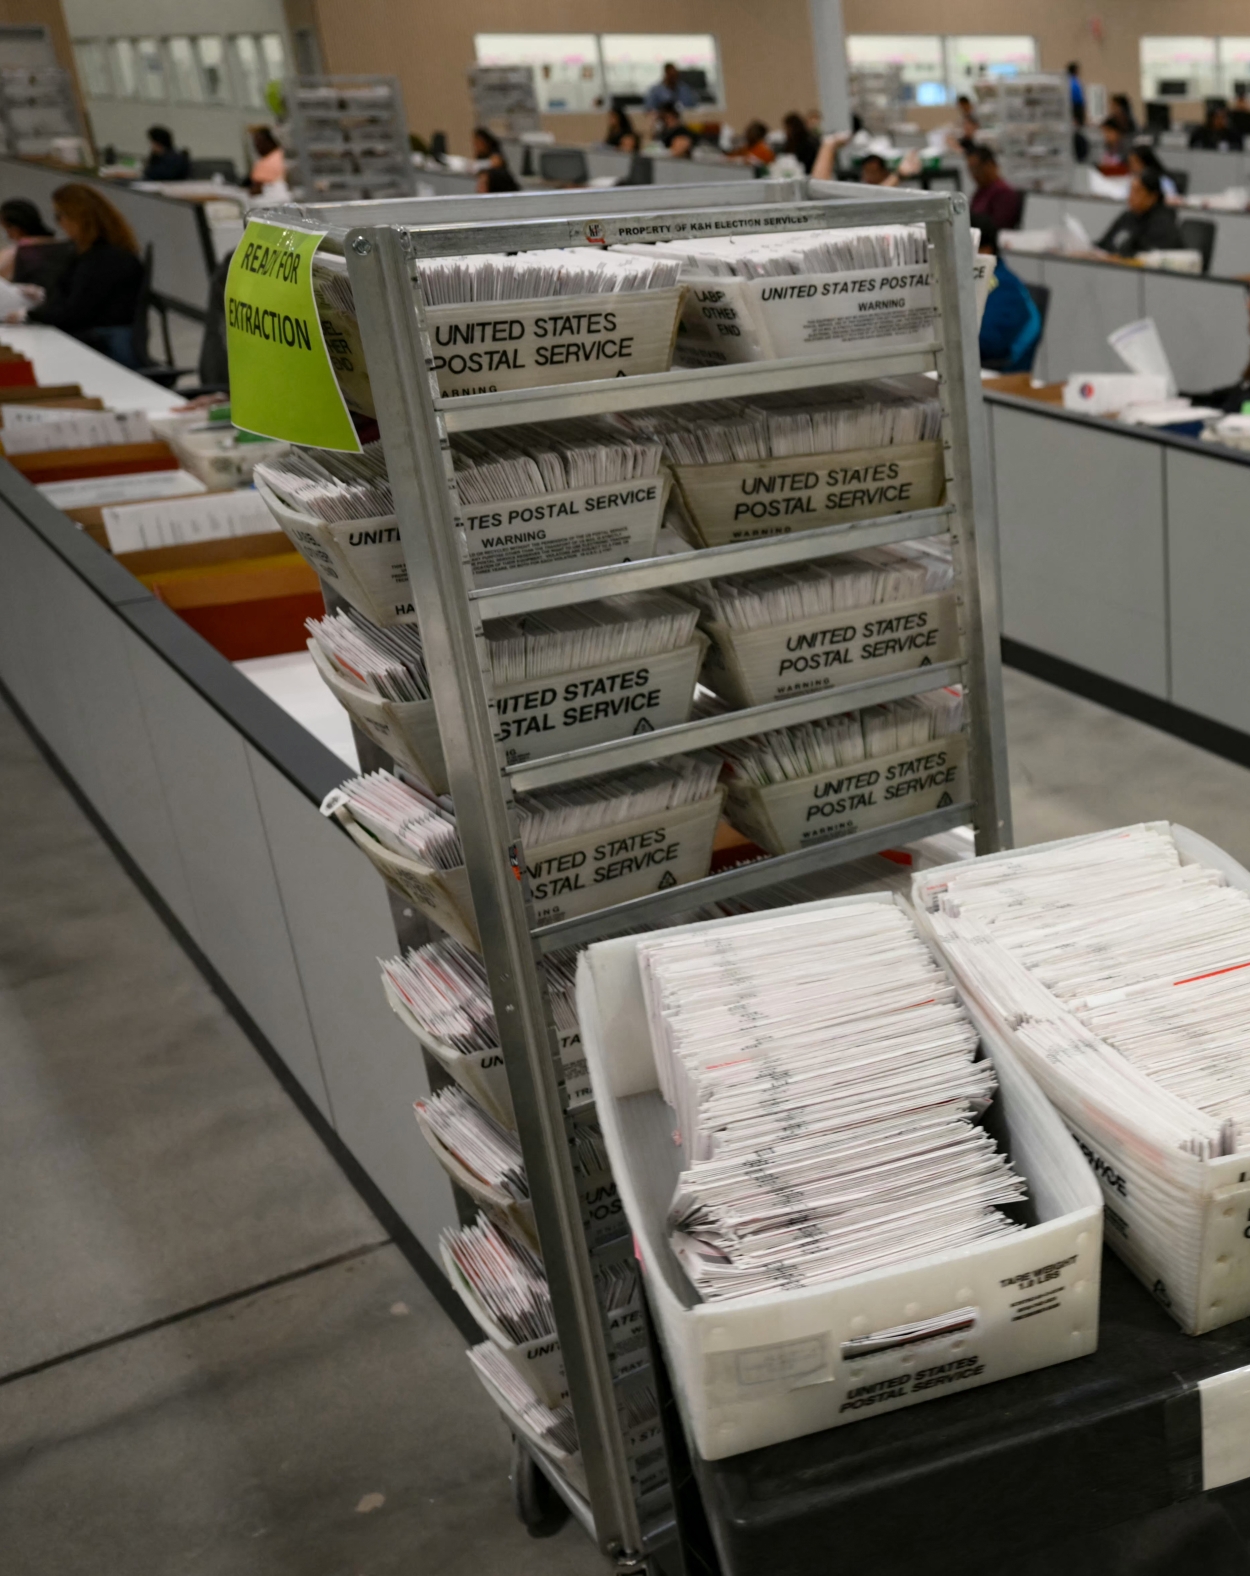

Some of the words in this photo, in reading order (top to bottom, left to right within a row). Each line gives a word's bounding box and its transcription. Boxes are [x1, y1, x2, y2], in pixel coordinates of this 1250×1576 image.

[619, 224, 671, 236] PROPERTY
[674, 223, 687, 232] OF
[690, 221, 712, 231] K&H
[714, 218, 759, 229] ELECTION
[763, 215, 808, 226] SERVICES
[241, 242, 278, 277] READY
[277, 251, 301, 285] FOR
[761, 284, 818, 302] UNITED
[821, 279, 876, 296] STATES
[879, 274, 932, 291] POSTAL
[858, 298, 905, 312] WARNING
[229, 298, 312, 351] EXTRACTION
[435, 319, 525, 346] UNITED
[534, 312, 617, 338] STATES
[429, 349, 525, 375] POSTAL
[535, 337, 634, 366] SERVICE
[441, 385, 498, 398] ARNING
[741, 471, 819, 496] UNITED
[826, 462, 899, 486] STATES
[349, 527, 402, 547] UNIT
[466, 511, 503, 532] TES
[508, 502, 580, 528] POSTAL
[584, 485, 657, 513] SERVICE
[734, 495, 816, 521] POSTAL
[825, 482, 912, 511] SERVICE
[481, 529, 546, 548] WARNING
[786, 625, 856, 652] UNITED
[862, 611, 928, 639] STATES
[778, 647, 854, 677] POSTAL
[860, 629, 939, 660] SERVICE
[496, 687, 557, 716] ITED
[563, 668, 650, 702] STATES
[777, 677, 831, 694] WARNING
[495, 713, 556, 742] STAL
[563, 689, 661, 726] SERVICE
[805, 792, 877, 822] POSTAL
[884, 766, 957, 800] SERVICE
[813, 770, 880, 799] UNITED
[886, 751, 947, 781] STATES
[802, 820, 854, 838] WARNING
[526, 850, 586, 879] NITED
[593, 827, 666, 862] STATES
[531, 873, 585, 900] STAL
[593, 842, 680, 883] SERVICE
[839, 1386, 907, 1414] POSTAL
[911, 1364, 986, 1394] SERVICE
[846, 1373, 911, 1400] UNITED
[914, 1355, 979, 1381] STATES
